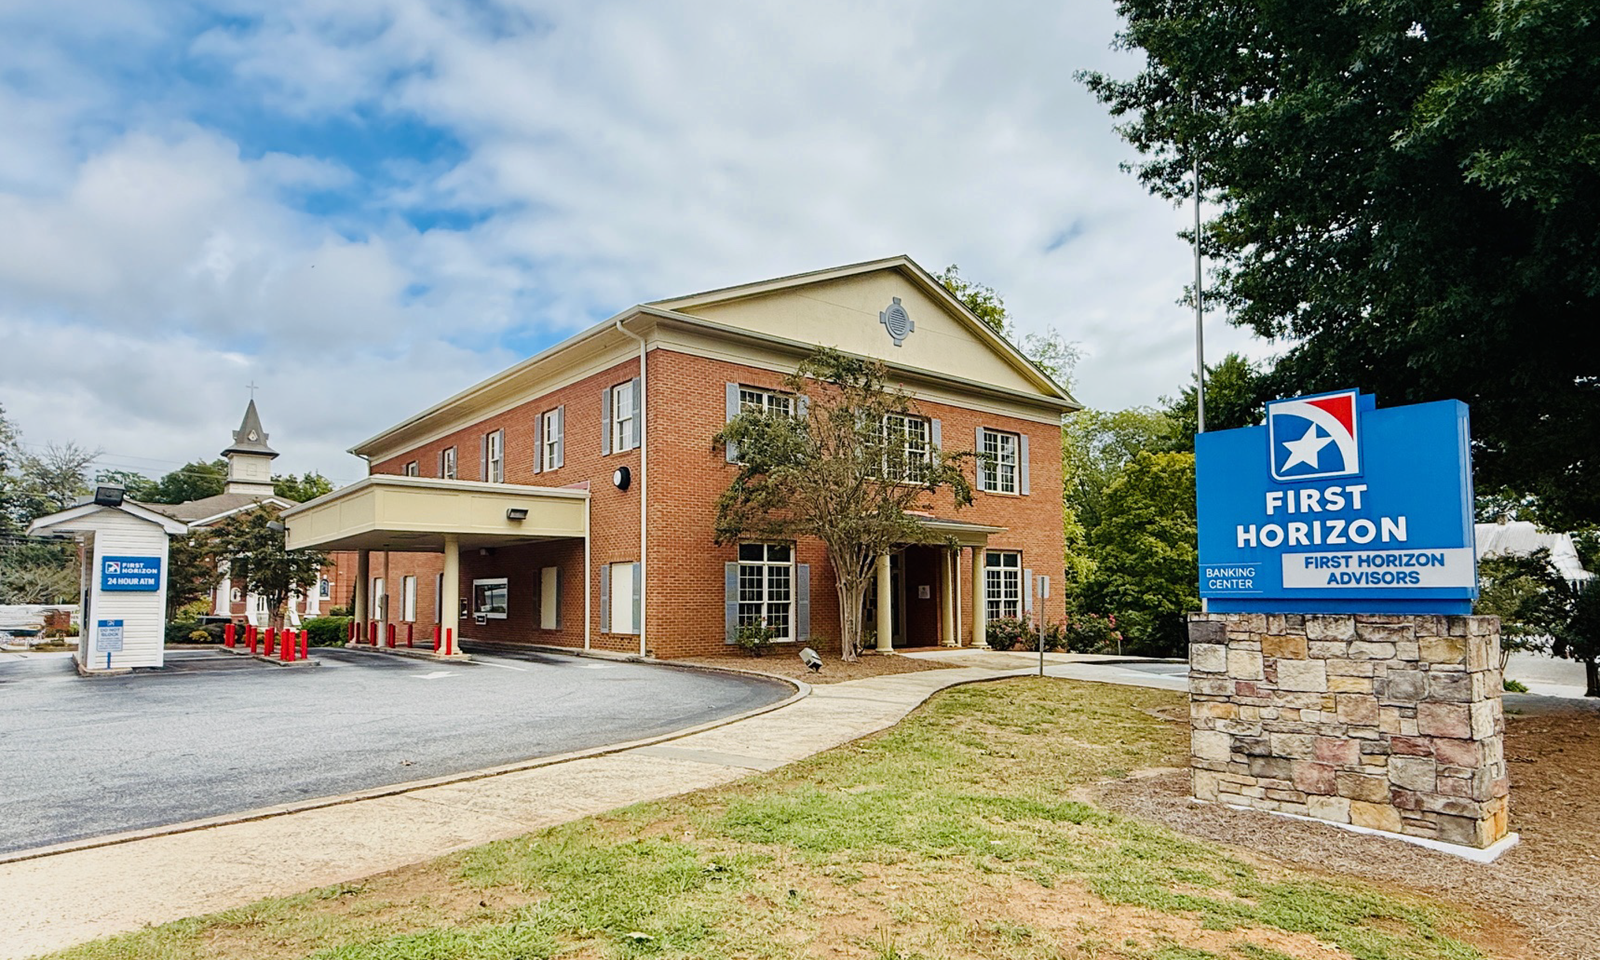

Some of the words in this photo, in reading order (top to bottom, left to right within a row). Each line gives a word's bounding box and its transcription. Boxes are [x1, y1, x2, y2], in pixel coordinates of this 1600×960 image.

[1265, 484, 1367, 515] FIRST
[1236, 516, 1407, 548] HORIZON
[1304, 555, 1353, 569] FIRST
[1357, 552, 1445, 568] HORIZON
[1206, 567, 1255, 578] BANKING
[1326, 570, 1420, 585] ADVISORS
[1208, 579, 1253, 589] CENTER
